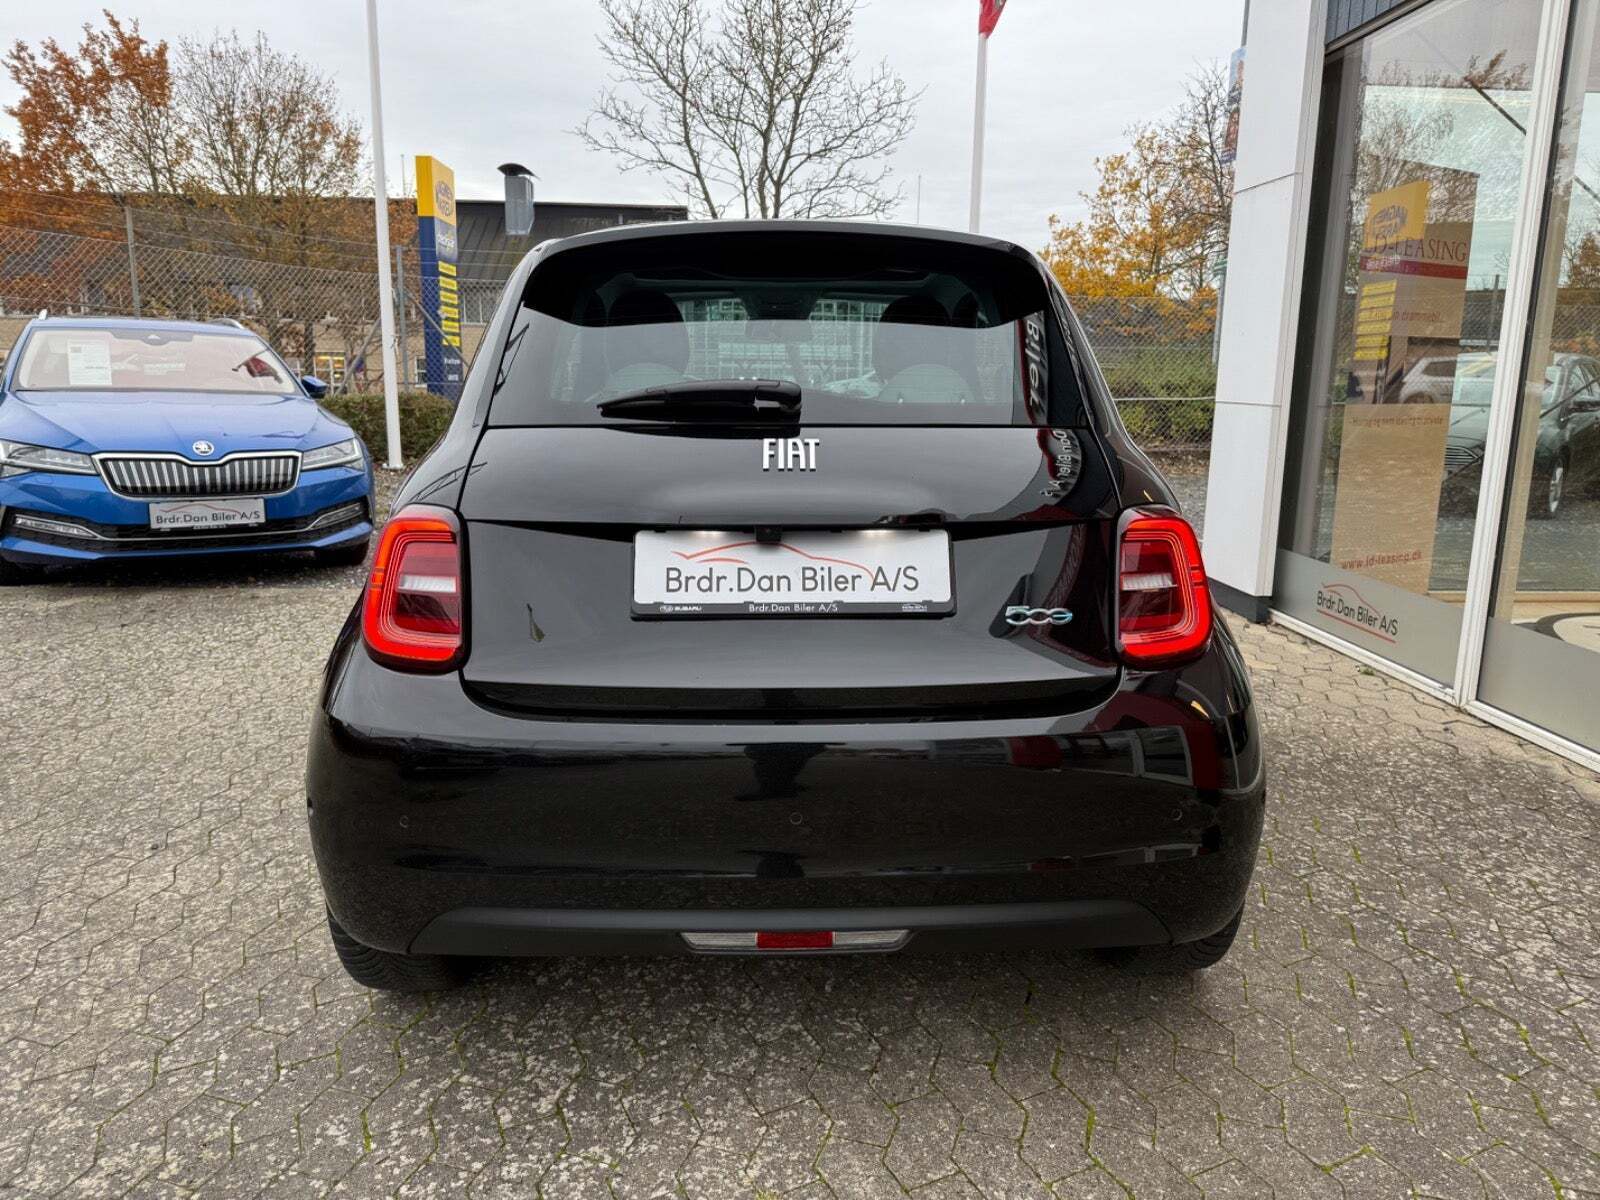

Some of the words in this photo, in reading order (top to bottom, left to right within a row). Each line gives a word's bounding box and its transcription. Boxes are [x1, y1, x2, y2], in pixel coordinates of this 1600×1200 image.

[762, 438, 820, 472] FIAT
[156, 513, 208, 525] Brdr.Dan
[211, 511, 237, 521] Biler
[240, 510, 261, 521] A/S
[665, 566, 791, 593] Brdr.Dan
[801, 565, 863, 593] Biler
[869, 565, 920, 593] A/S
[748, 603, 791, 613] Brdr.Dan
[793, 603, 815, 612] Biler
[818, 604, 839, 613] A/S
[1316, 590, 1355, 617] Brdr.Dan
[1356, 605, 1379, 627] Biler
[1379, 615, 1398, 636] A/S
